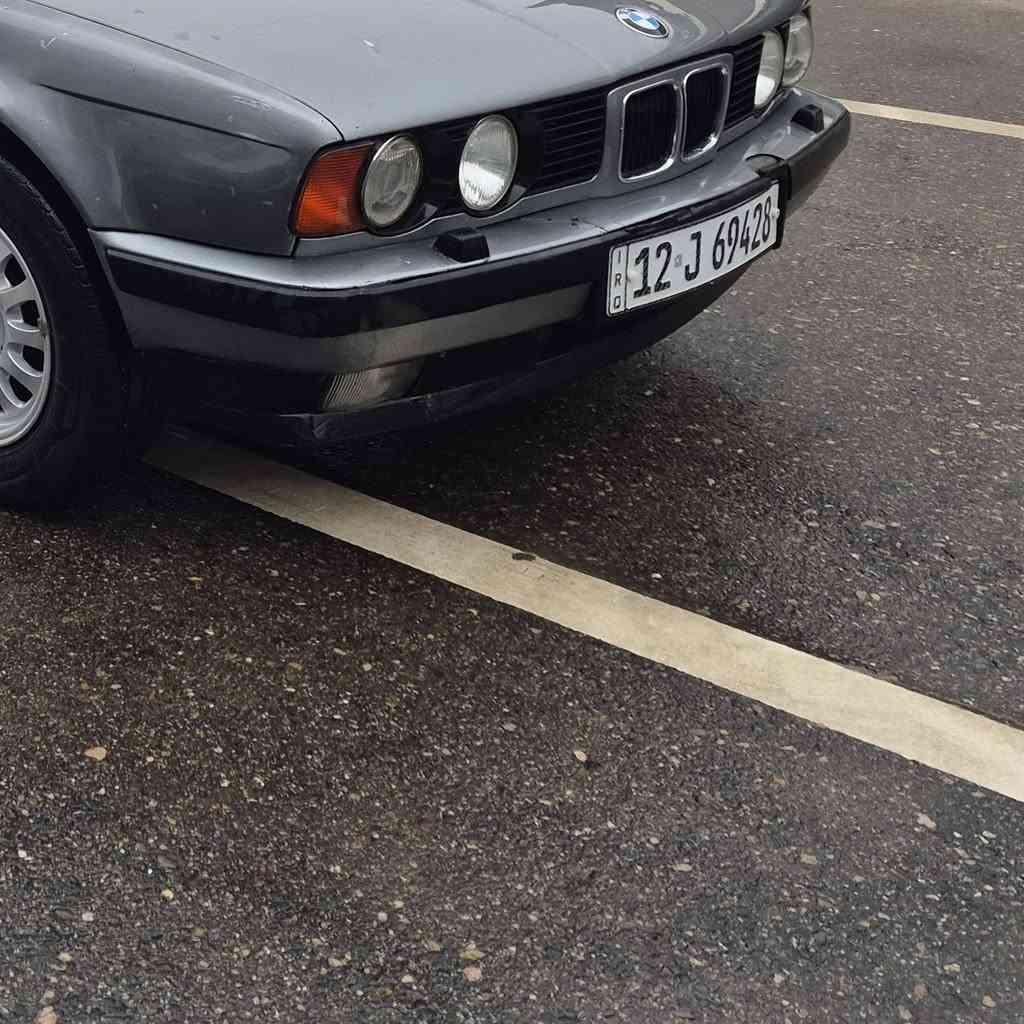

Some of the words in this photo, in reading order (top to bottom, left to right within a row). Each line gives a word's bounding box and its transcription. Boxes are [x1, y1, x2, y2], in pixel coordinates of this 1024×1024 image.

[632, 241, 673, 299] 12
[684, 231, 703, 281] J
[712, 195, 772, 271] 69428
